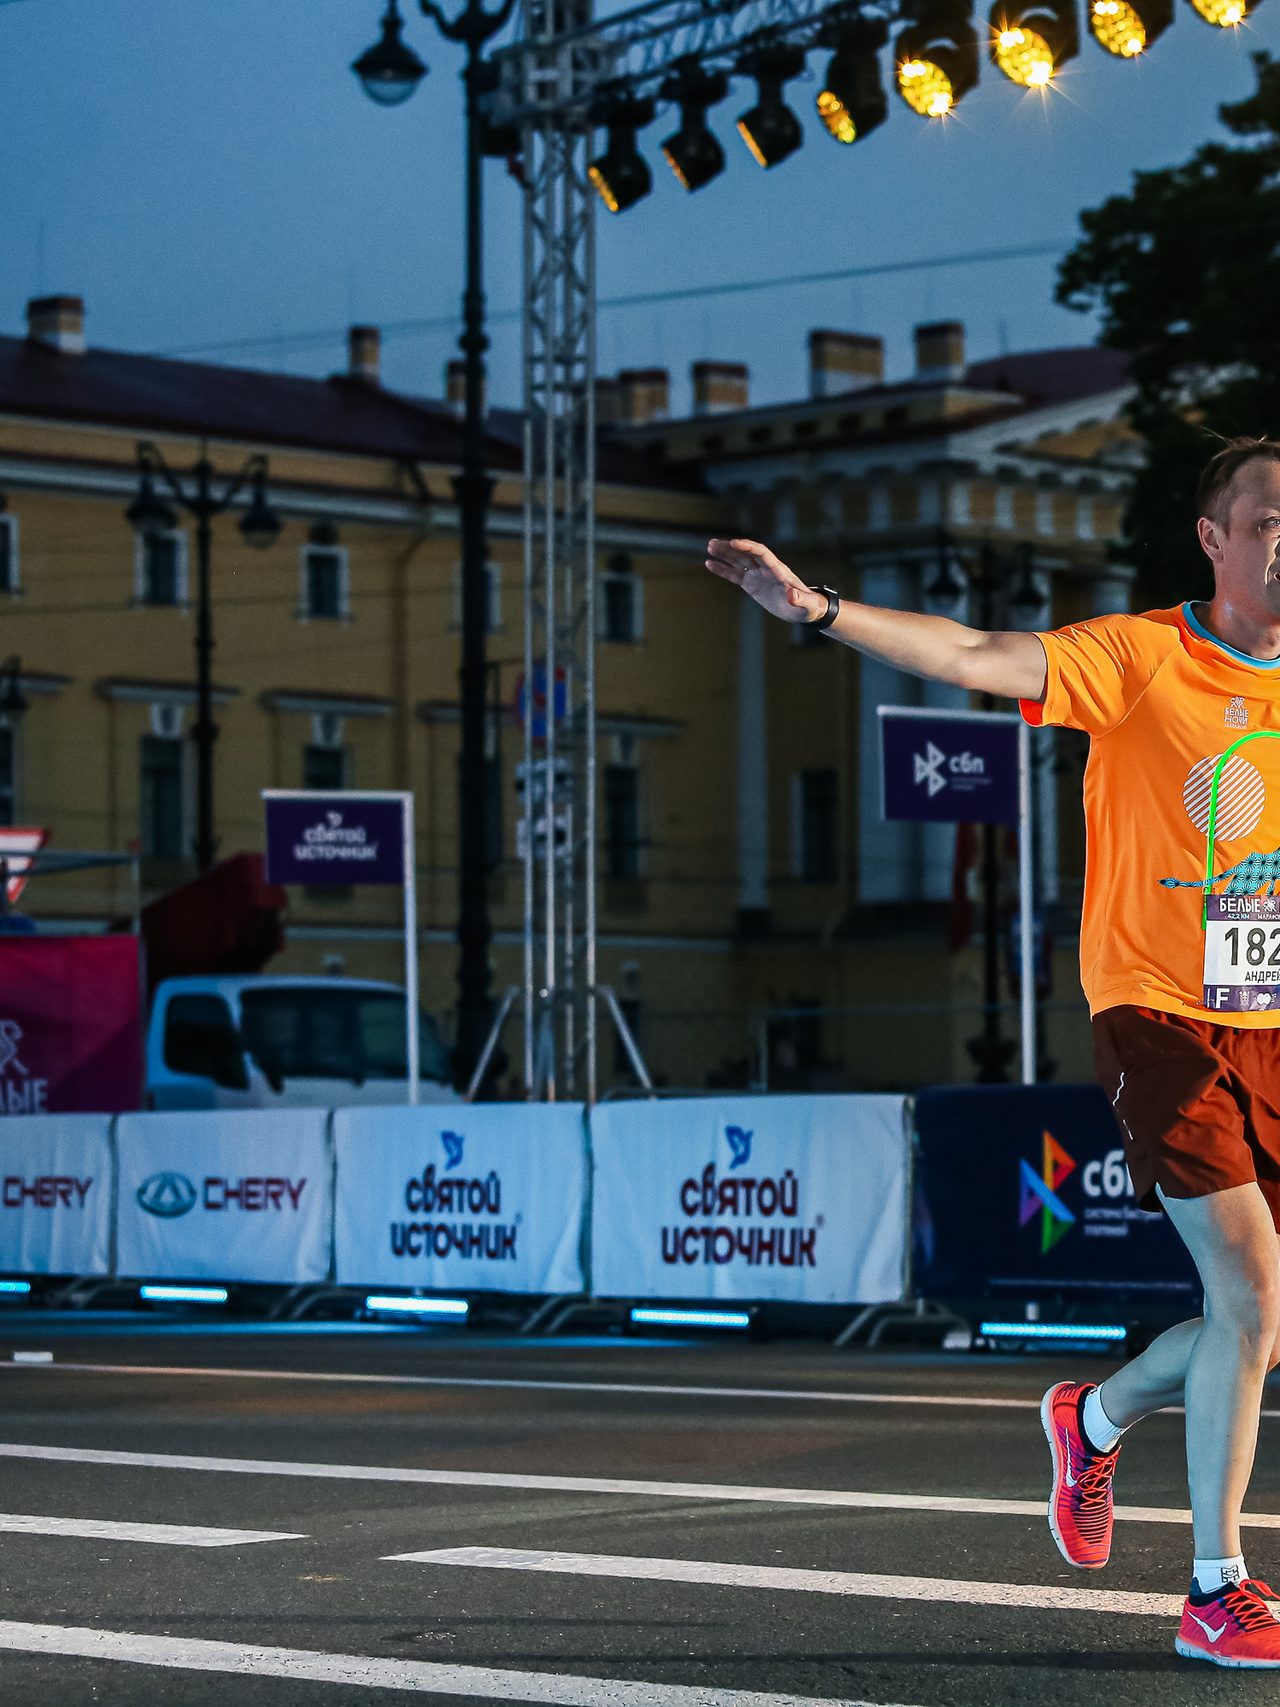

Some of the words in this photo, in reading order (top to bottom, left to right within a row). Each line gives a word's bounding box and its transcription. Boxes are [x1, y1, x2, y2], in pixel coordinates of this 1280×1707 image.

[1224, 715, 1248, 725] НОЧИ
[1225, 707, 1248, 717] БЕЛЫЕ
[949, 751, 985, 774] сбп
[1219, 898, 1260, 913] БЕЛЫЕ
[1215, 988, 1230, 1009] F
[3, 1176, 94, 1208] CHERY
[203, 1177, 307, 1211] CHERY
